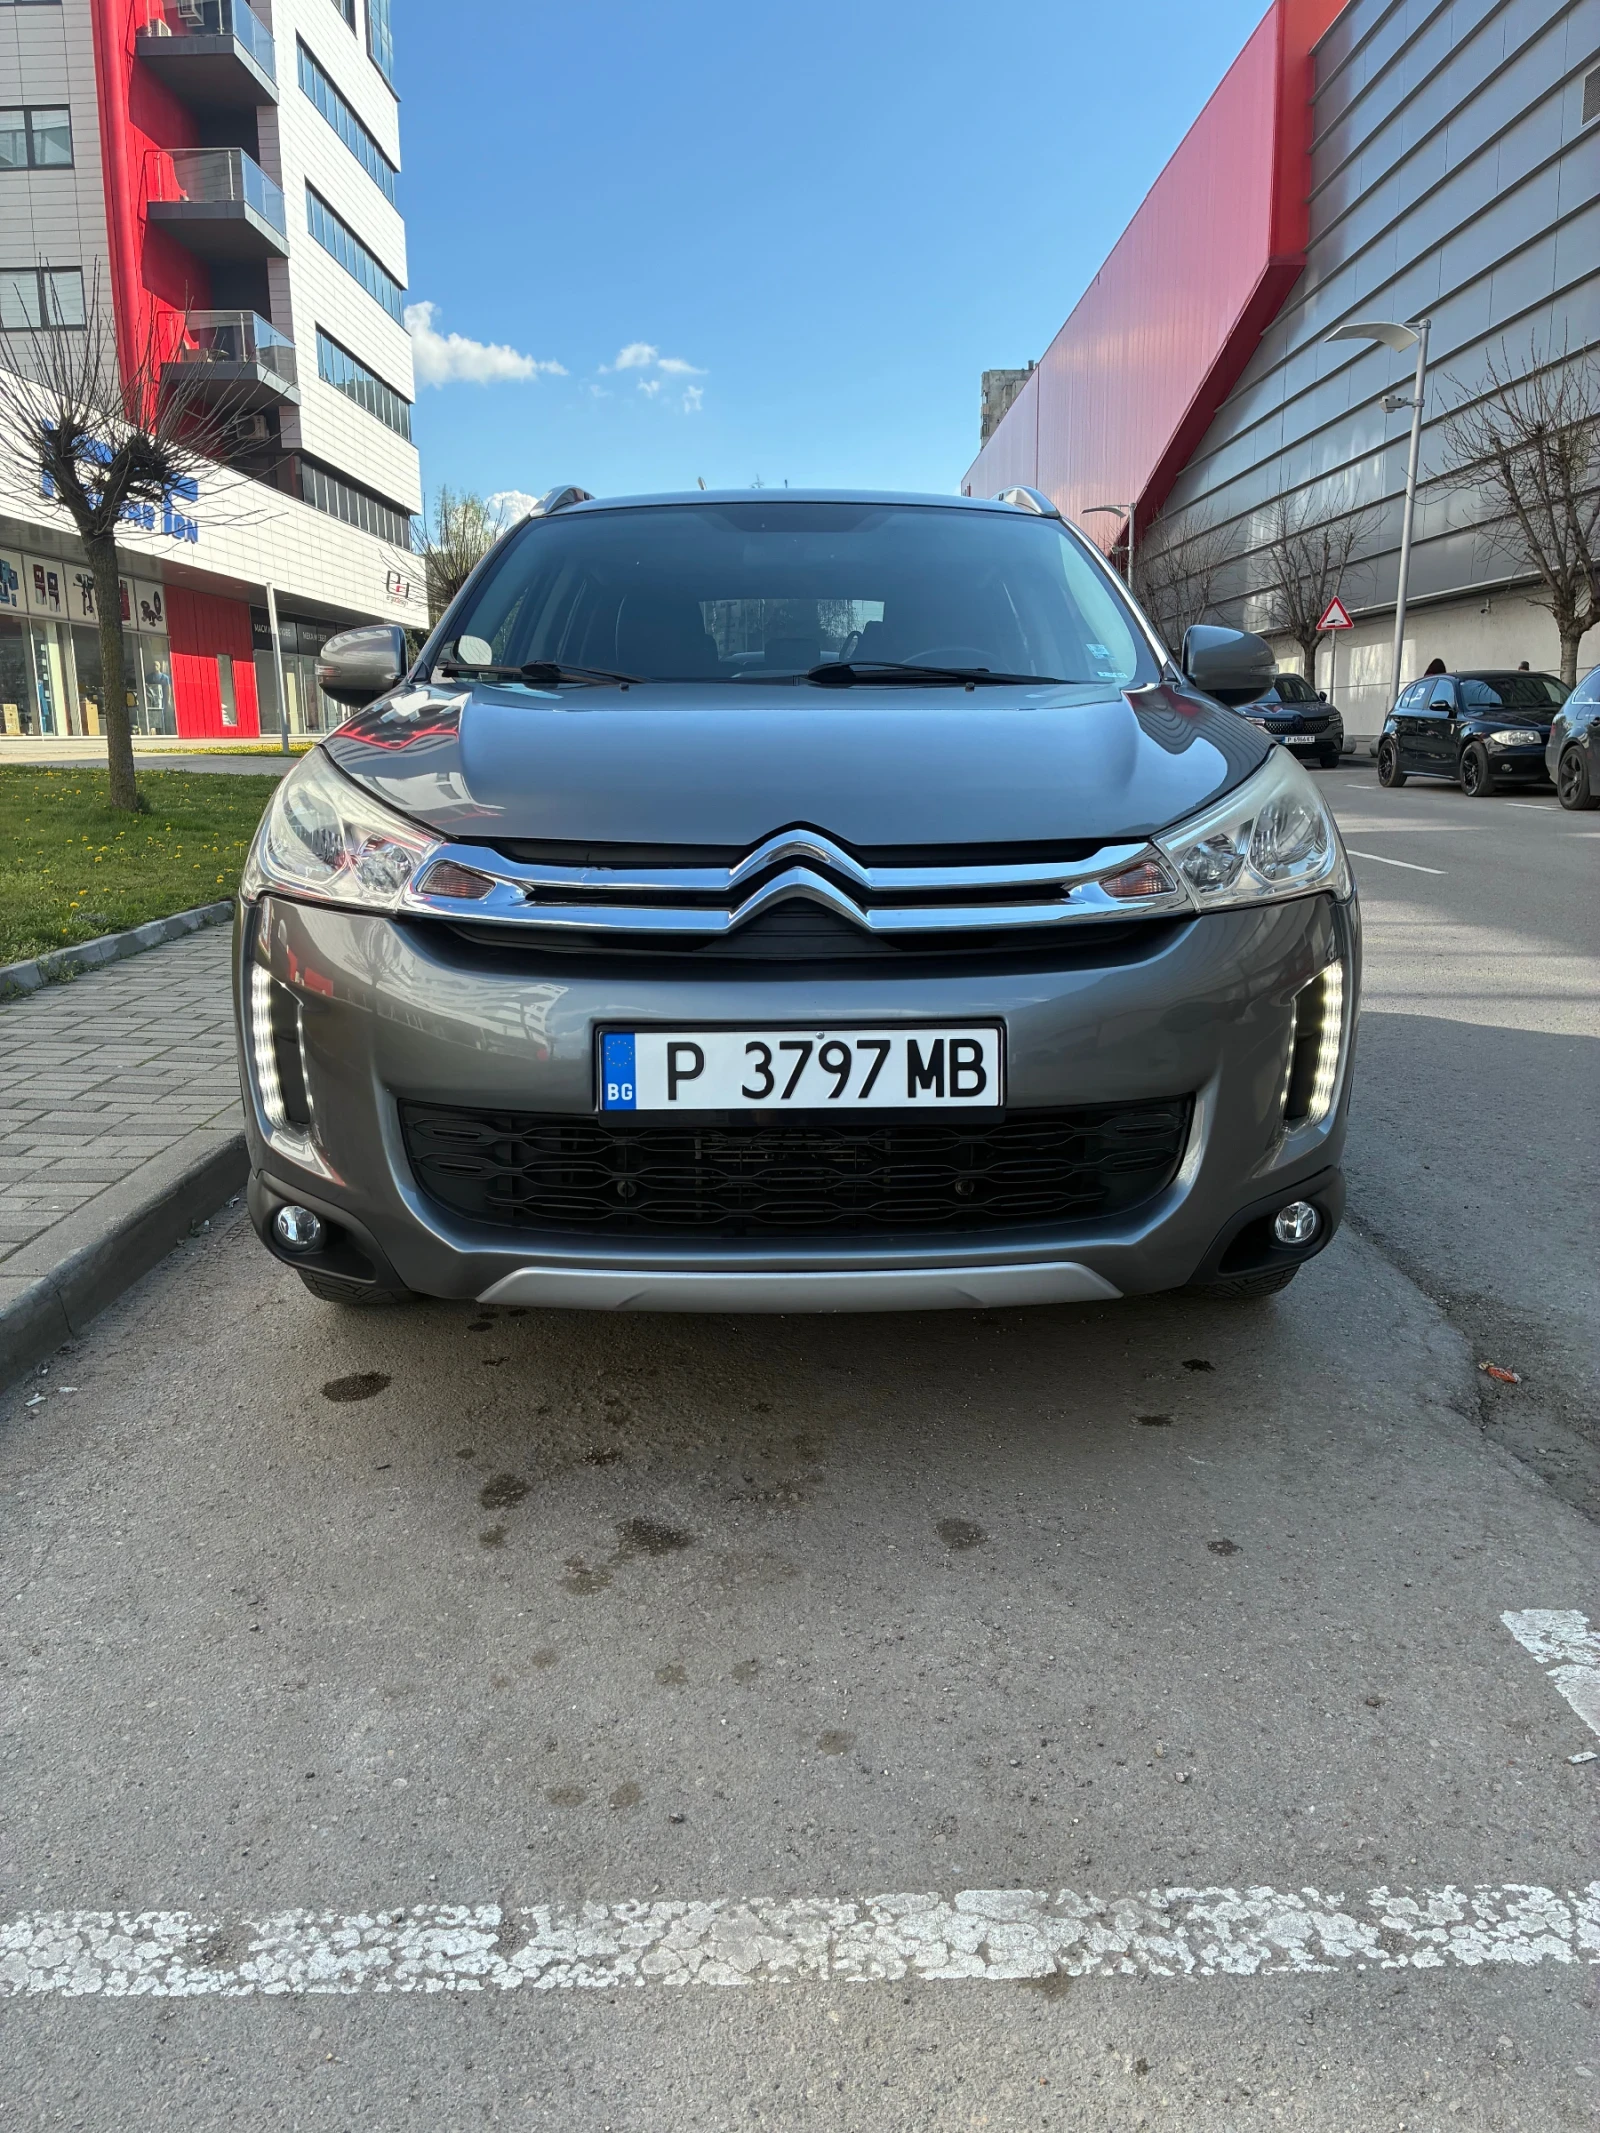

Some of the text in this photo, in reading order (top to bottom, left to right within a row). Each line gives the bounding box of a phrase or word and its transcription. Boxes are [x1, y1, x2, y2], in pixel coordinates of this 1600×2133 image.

[666, 1038, 988, 1101] P 3797 MB
[607, 1083, 633, 1101] BG
